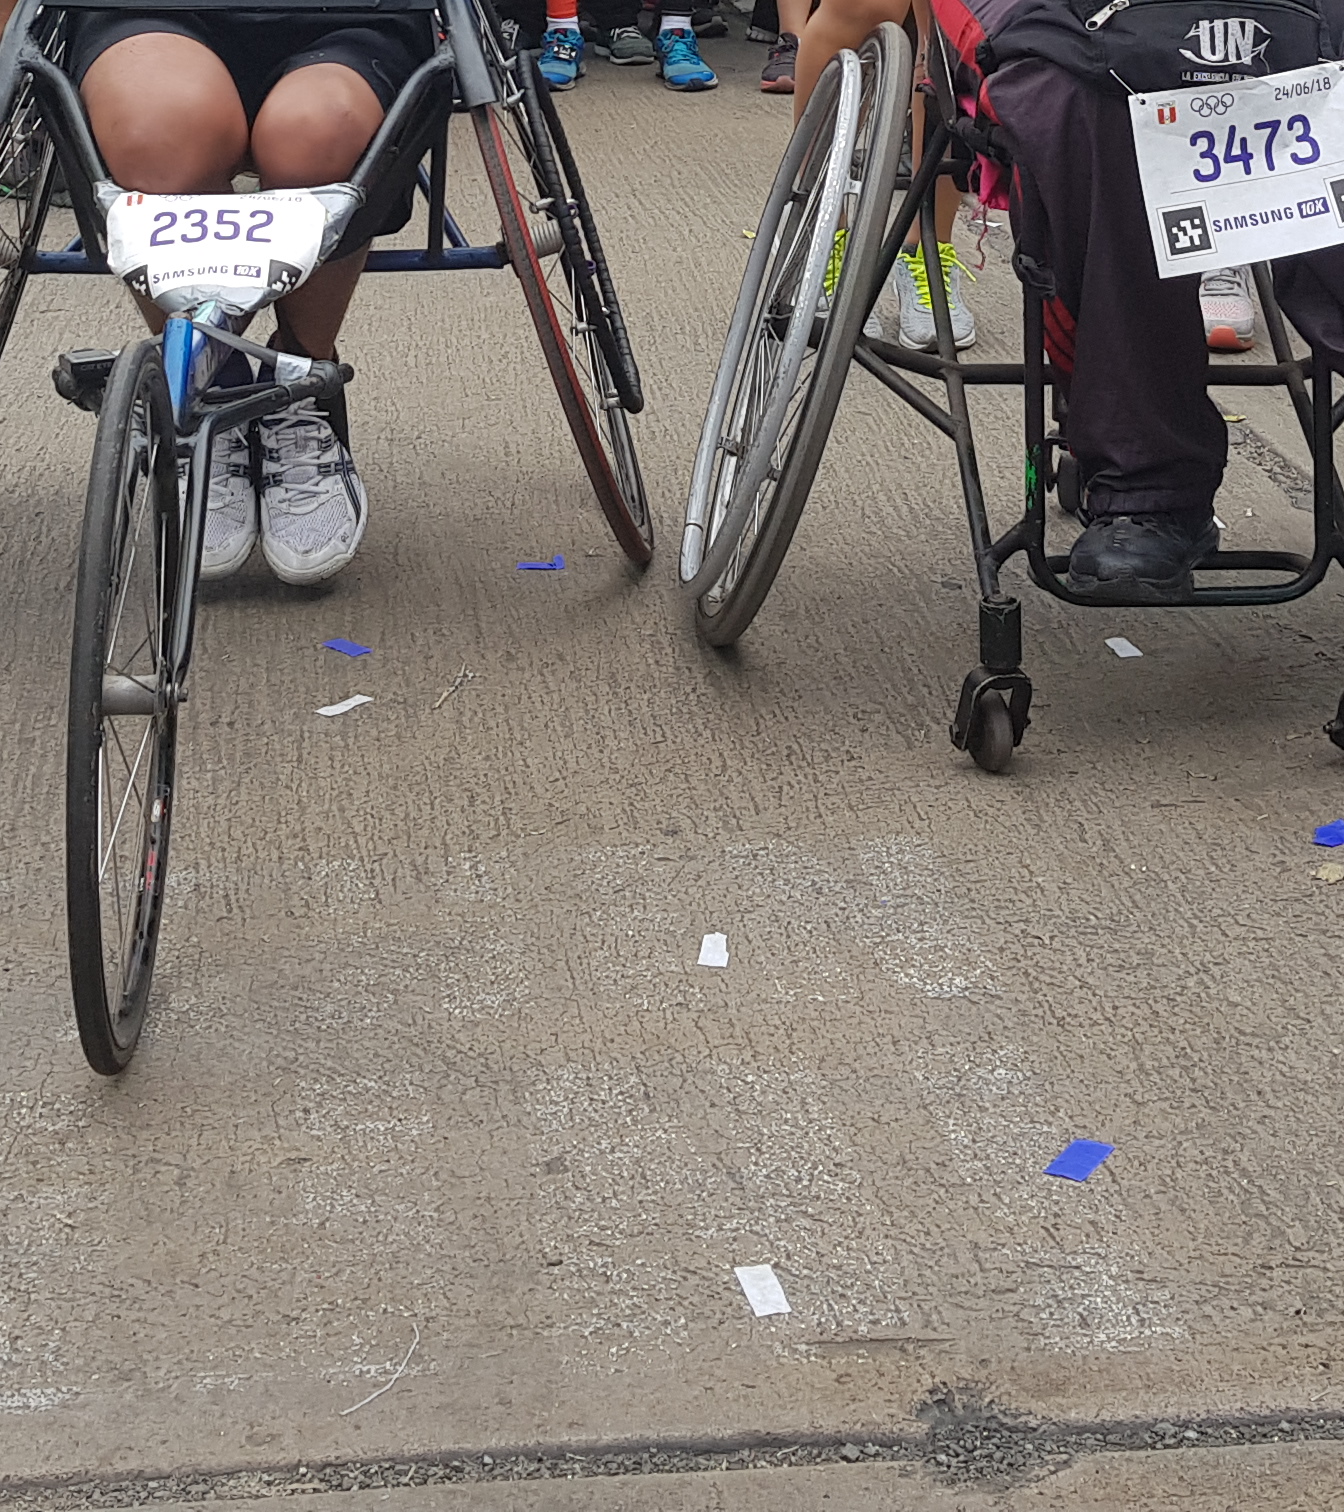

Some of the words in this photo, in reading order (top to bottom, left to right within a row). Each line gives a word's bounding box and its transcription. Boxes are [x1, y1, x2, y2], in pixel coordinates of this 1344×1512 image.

[1274, 76, 1332, 101] 24/06/18
[1189, 113, 1321, 183] 3473
[149, 208, 274, 247] 2352
[1212, 206, 1294, 233] SAMSUNG
[1298, 197, 1327, 219] 10K
[153, 265, 229, 284] SAMSUNG
[235, 265, 261, 278] 10K
